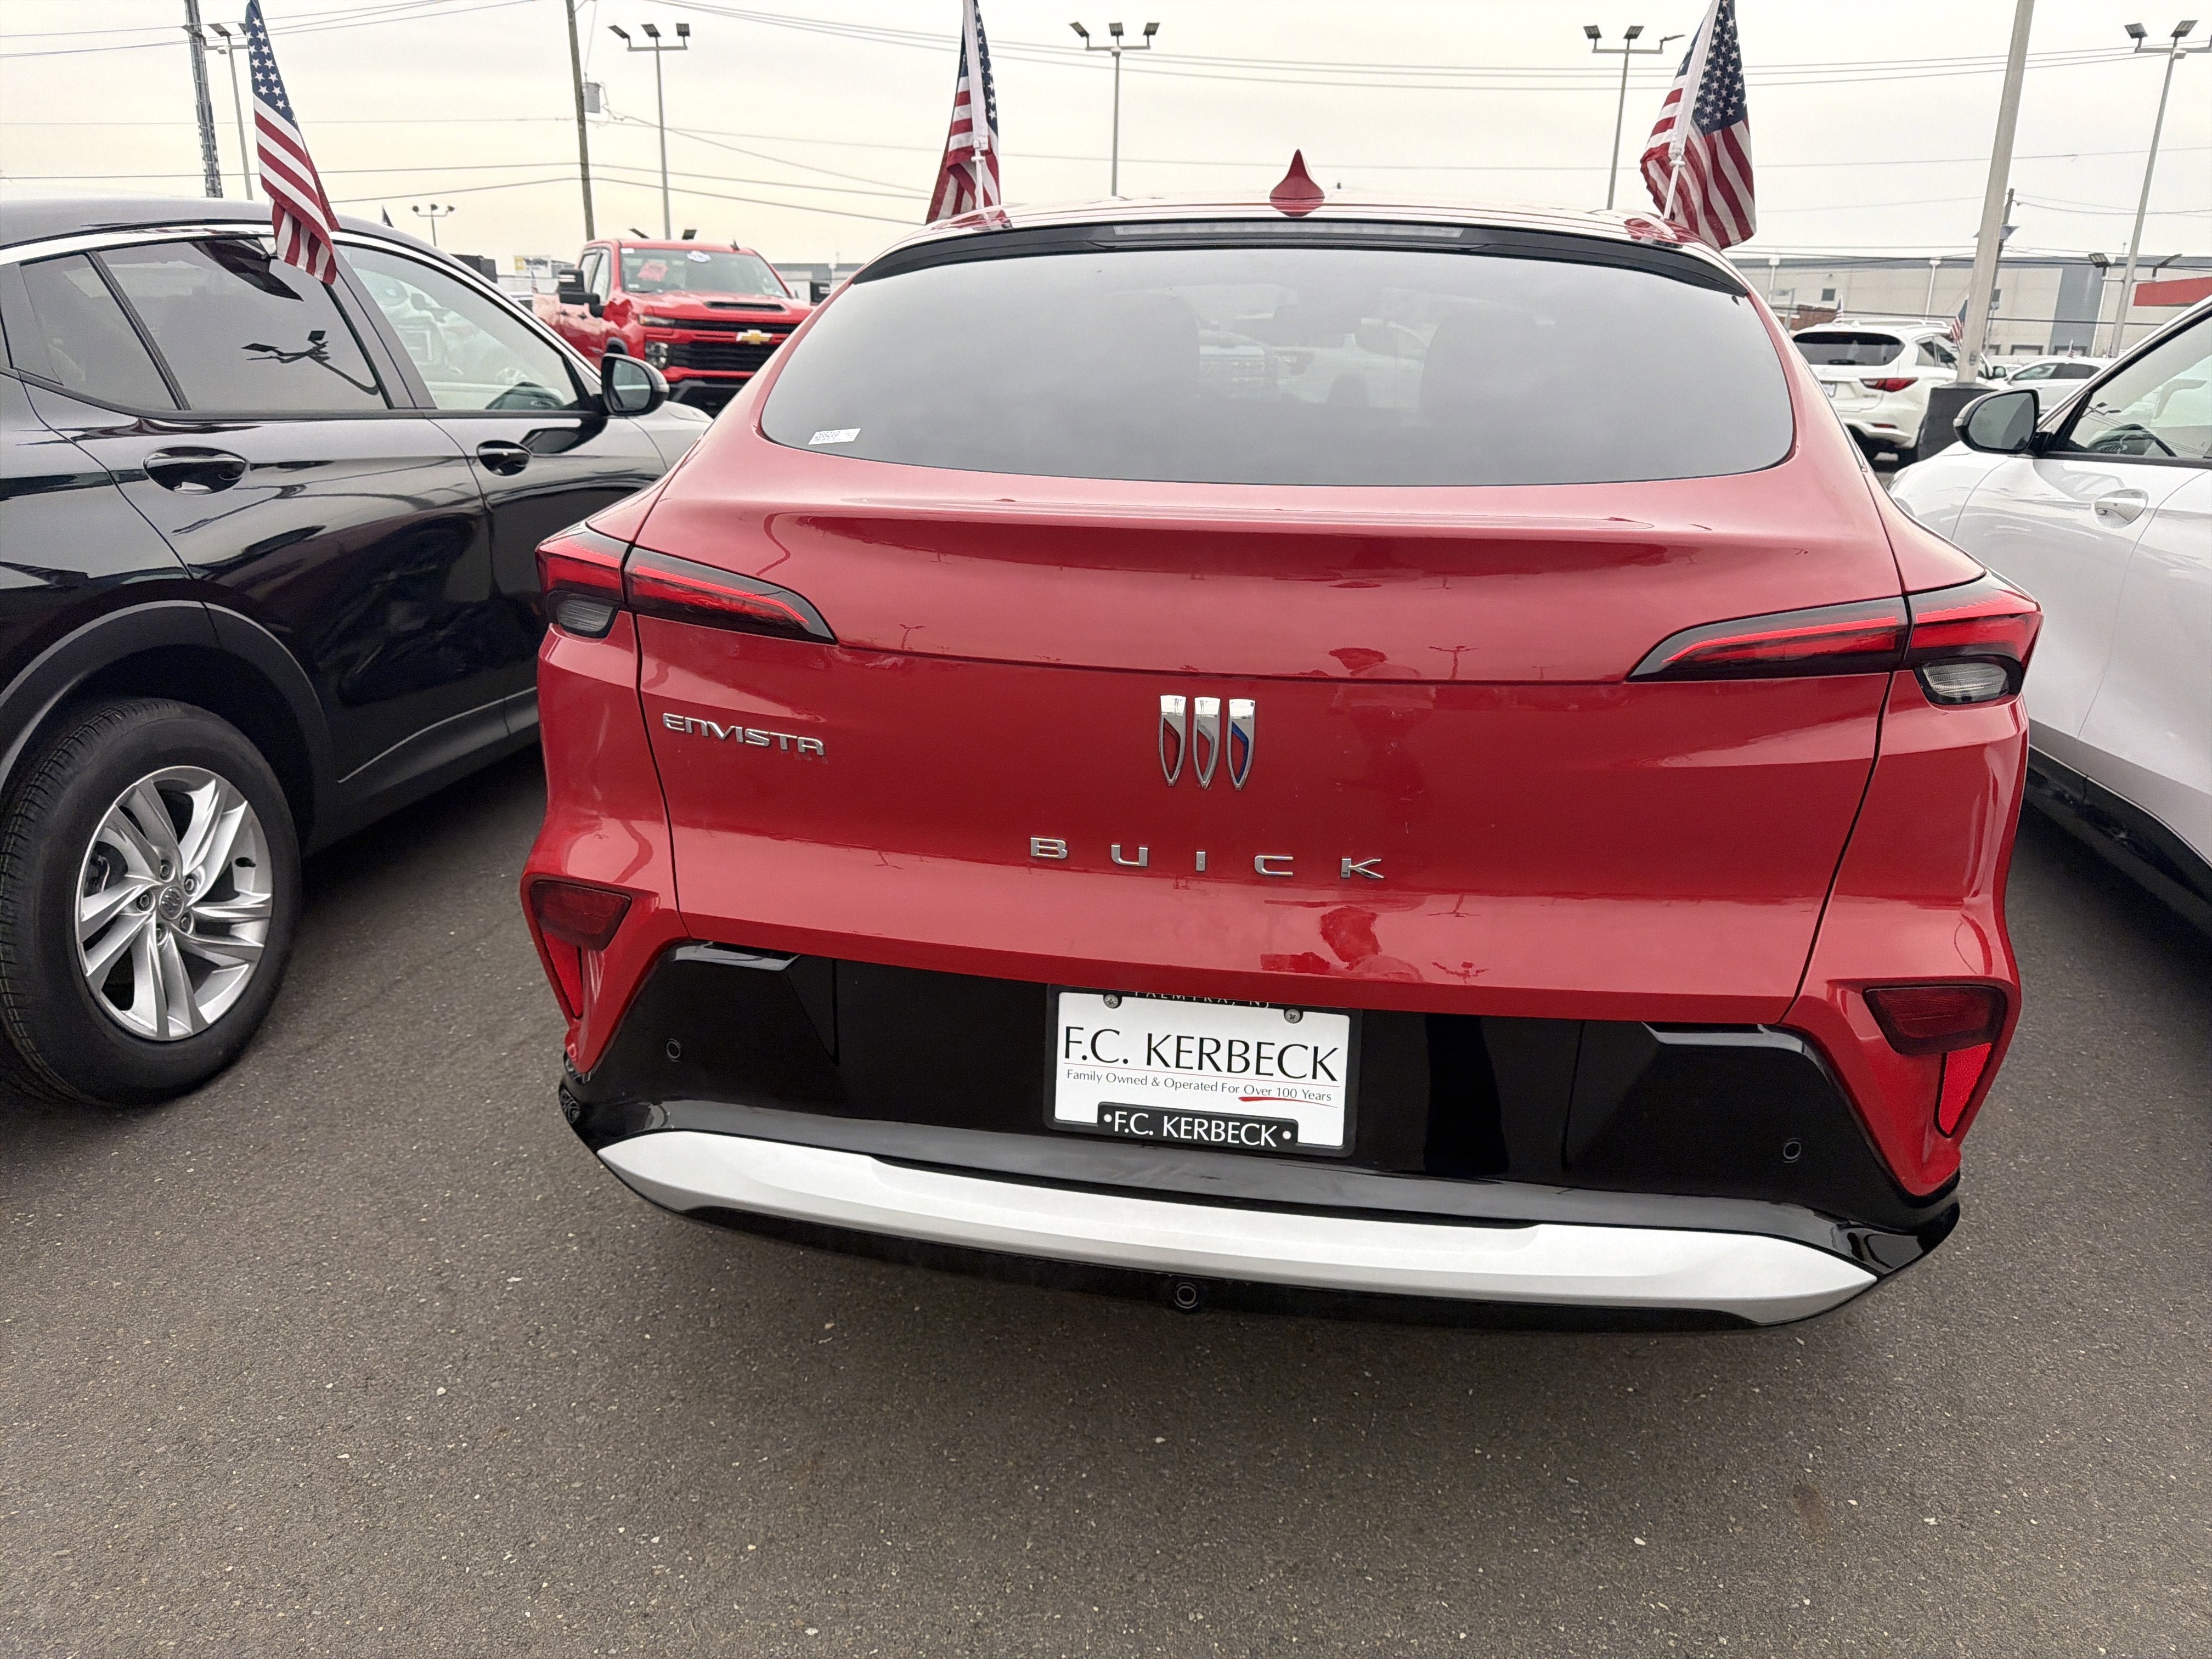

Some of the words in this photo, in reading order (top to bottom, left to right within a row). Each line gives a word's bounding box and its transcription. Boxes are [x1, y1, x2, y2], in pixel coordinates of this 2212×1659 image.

[662, 713, 825, 756] ENVISTA
[1030, 836, 1384, 879] BUICK
[1064, 1025, 1129, 1064] F.C.
[1146, 1032, 1339, 1082] KERBECK
[1067, 1069, 1103, 1084] Family
[1106, 1073, 1148, 1086] Owned
[1152, 1077, 1160, 1086] &
[1164, 1077, 1217, 1092] Operated
[1222, 1082, 1240, 1093] For
[1244, 1085, 1272, 1096] Over
[1277, 1087, 1297, 1098] 100
[1302, 1089, 1331, 1102] Years
[1114, 1110, 1154, 1136] F.C.
[1163, 1115, 1278, 1148] KERBECK
